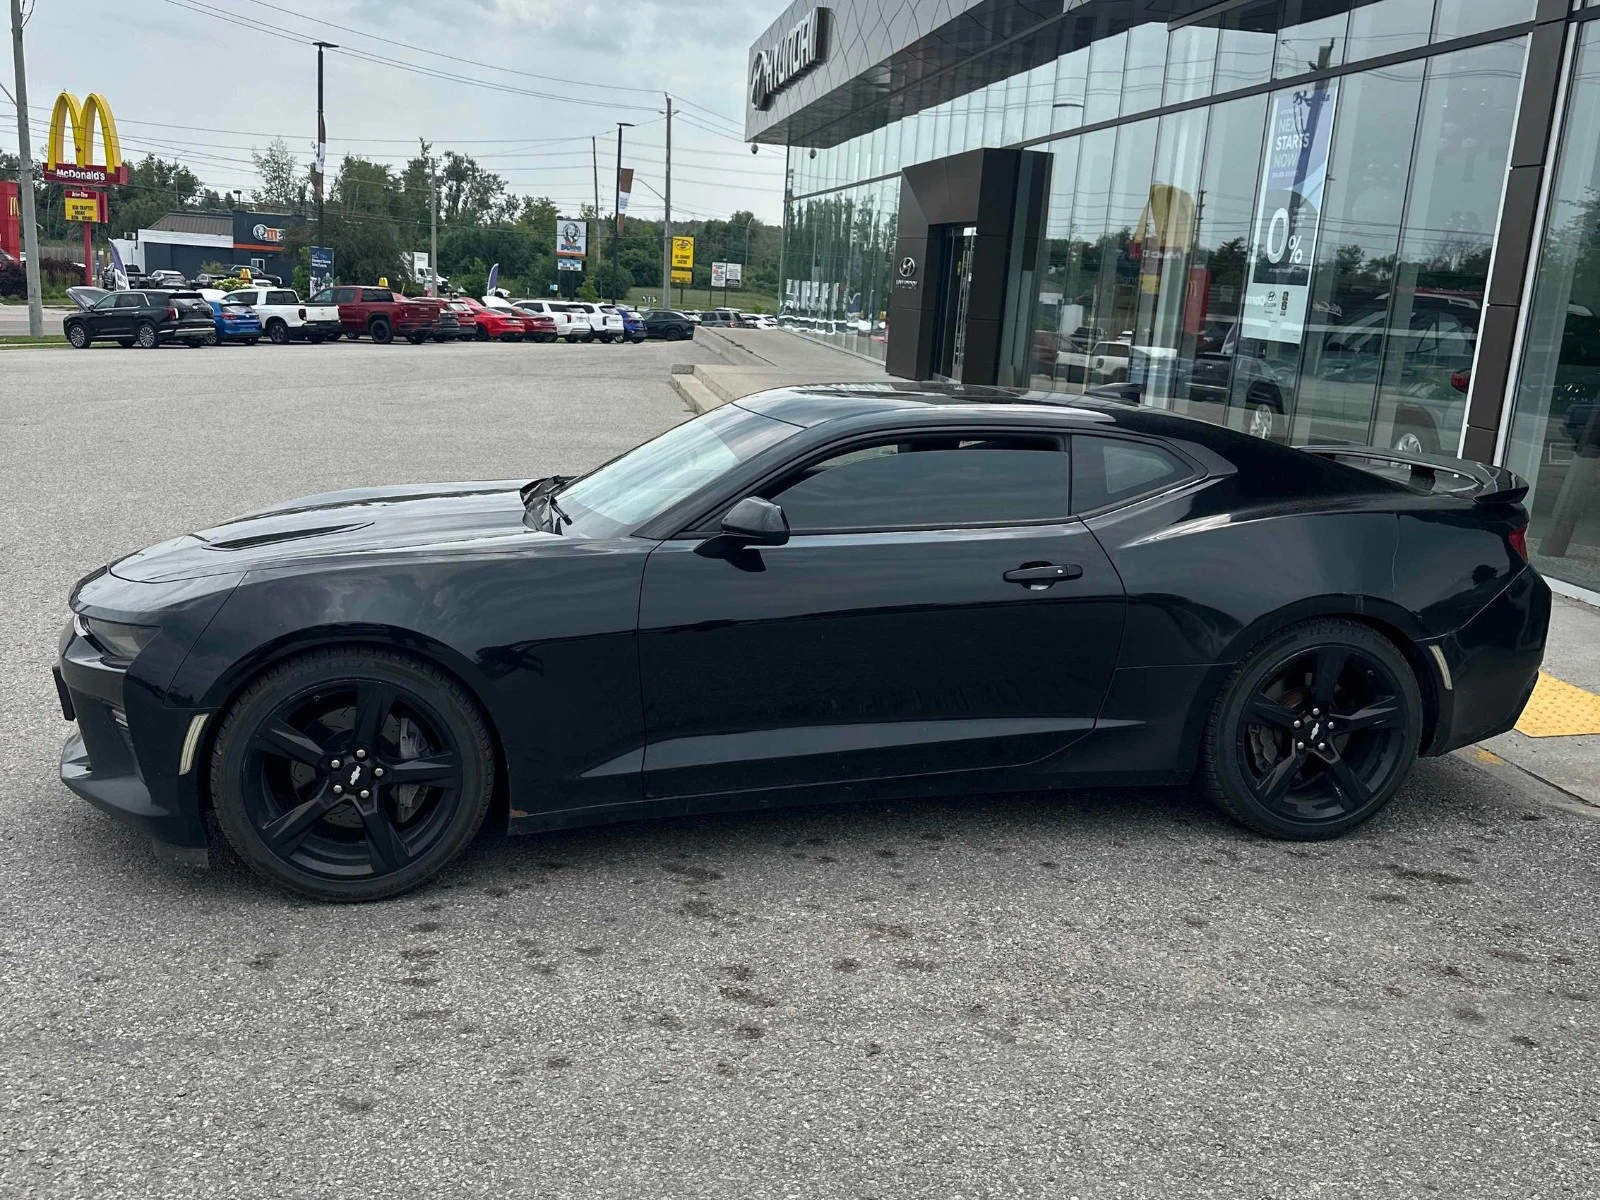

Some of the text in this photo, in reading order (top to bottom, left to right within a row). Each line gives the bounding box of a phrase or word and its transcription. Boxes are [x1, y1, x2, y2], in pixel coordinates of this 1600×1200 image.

[765, 7, 820, 94] HYUNDAI
[1275, 132, 1310, 151] STARTS
[1273, 152, 1298, 169] NOW
[56, 168, 106, 181] McDonald's
